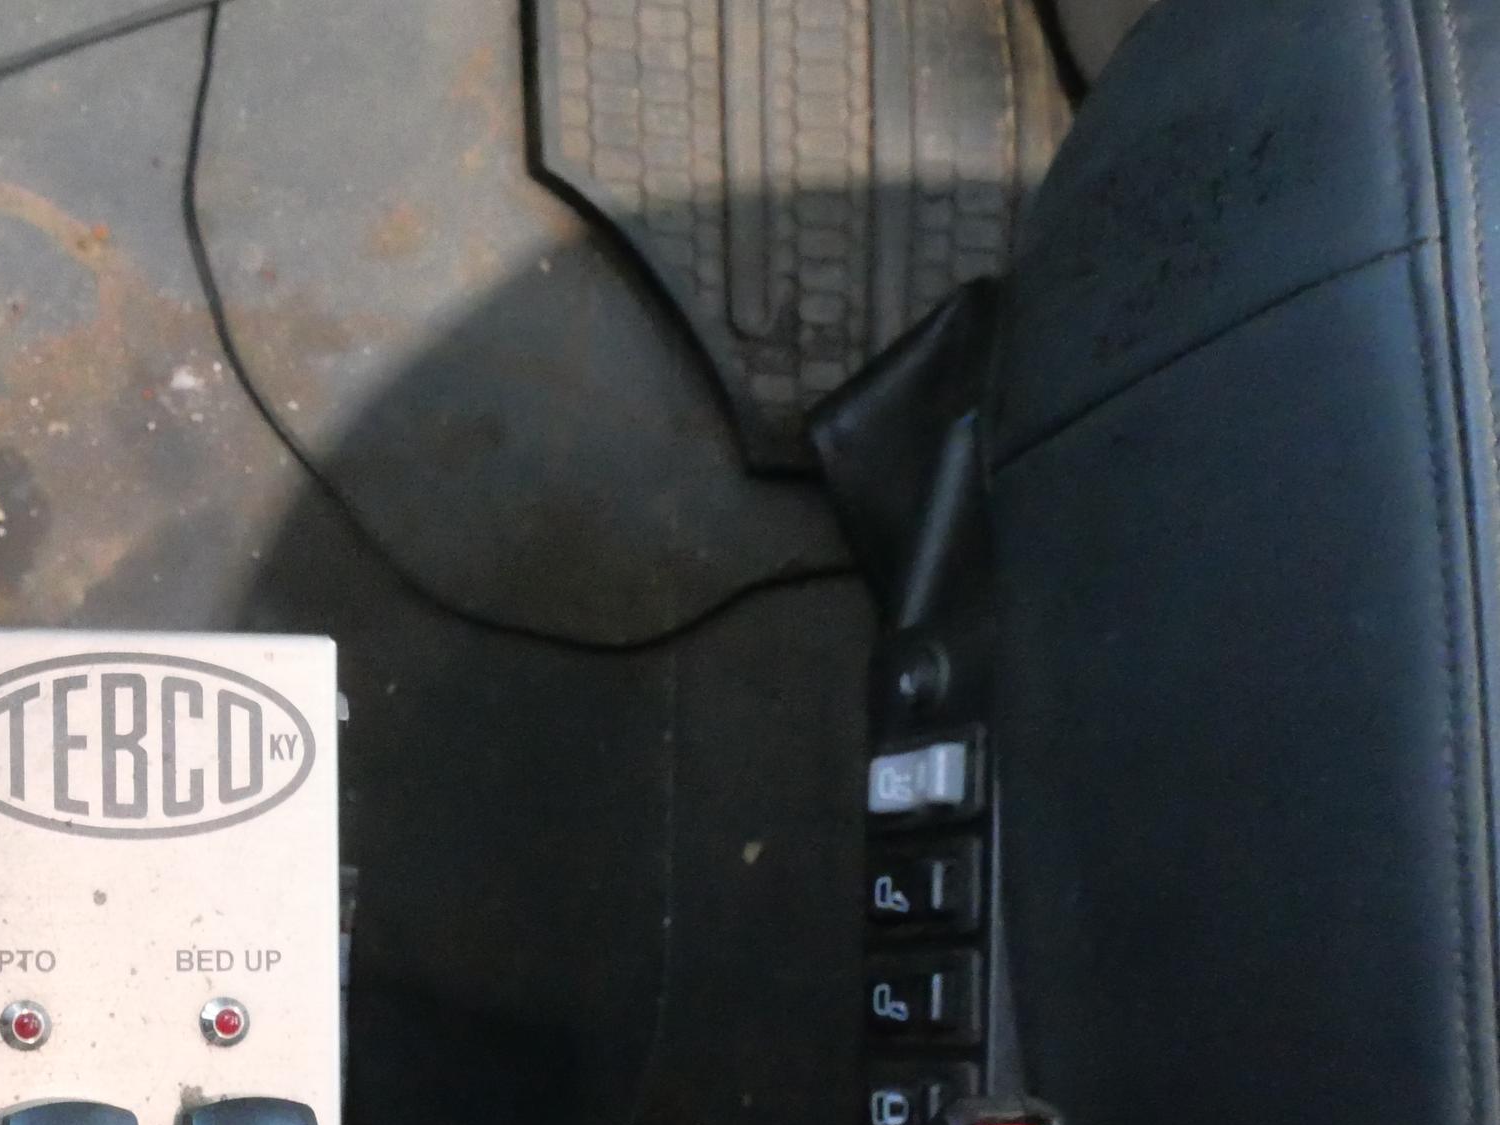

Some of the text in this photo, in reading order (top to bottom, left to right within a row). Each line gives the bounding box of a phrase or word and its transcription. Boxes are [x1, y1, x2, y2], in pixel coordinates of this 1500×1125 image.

[269, 733, 299, 761] KY
[175, 950, 282, 973] BED UP
